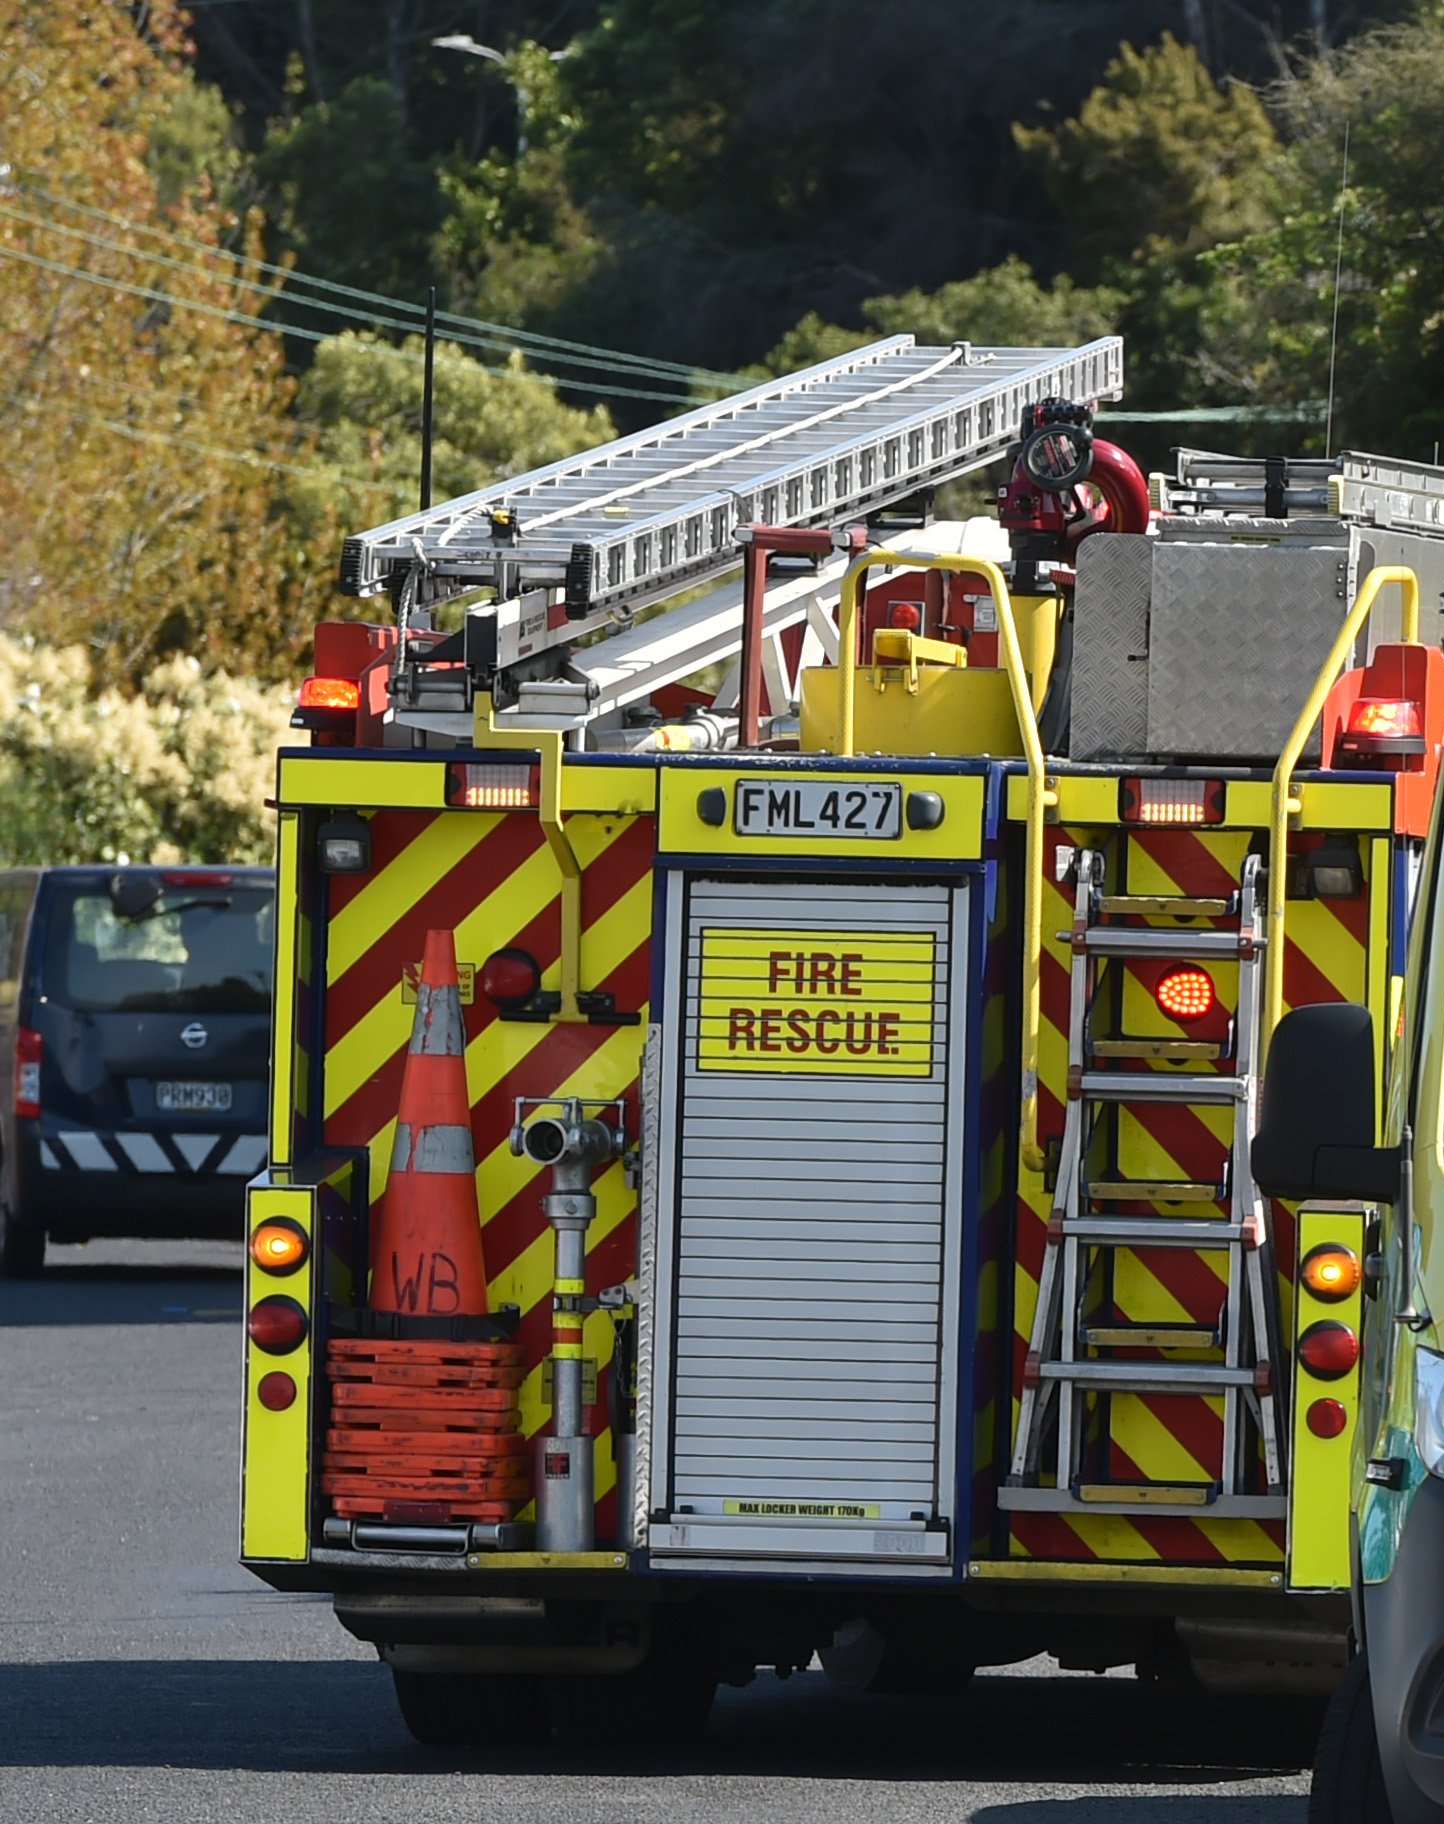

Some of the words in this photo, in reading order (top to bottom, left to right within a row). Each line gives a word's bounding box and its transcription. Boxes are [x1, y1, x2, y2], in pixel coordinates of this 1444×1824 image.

[743, 788, 894, 830] FML427
[768, 950, 863, 996] FIRE
[728, 1007, 901, 1056] RESCUE
[391, 1251, 460, 1314] WB
[738, 1502, 760, 1514] MAX
[761, 1503, 797, 1515] LOCKER
[798, 1504, 835, 1516] WEIGHT
